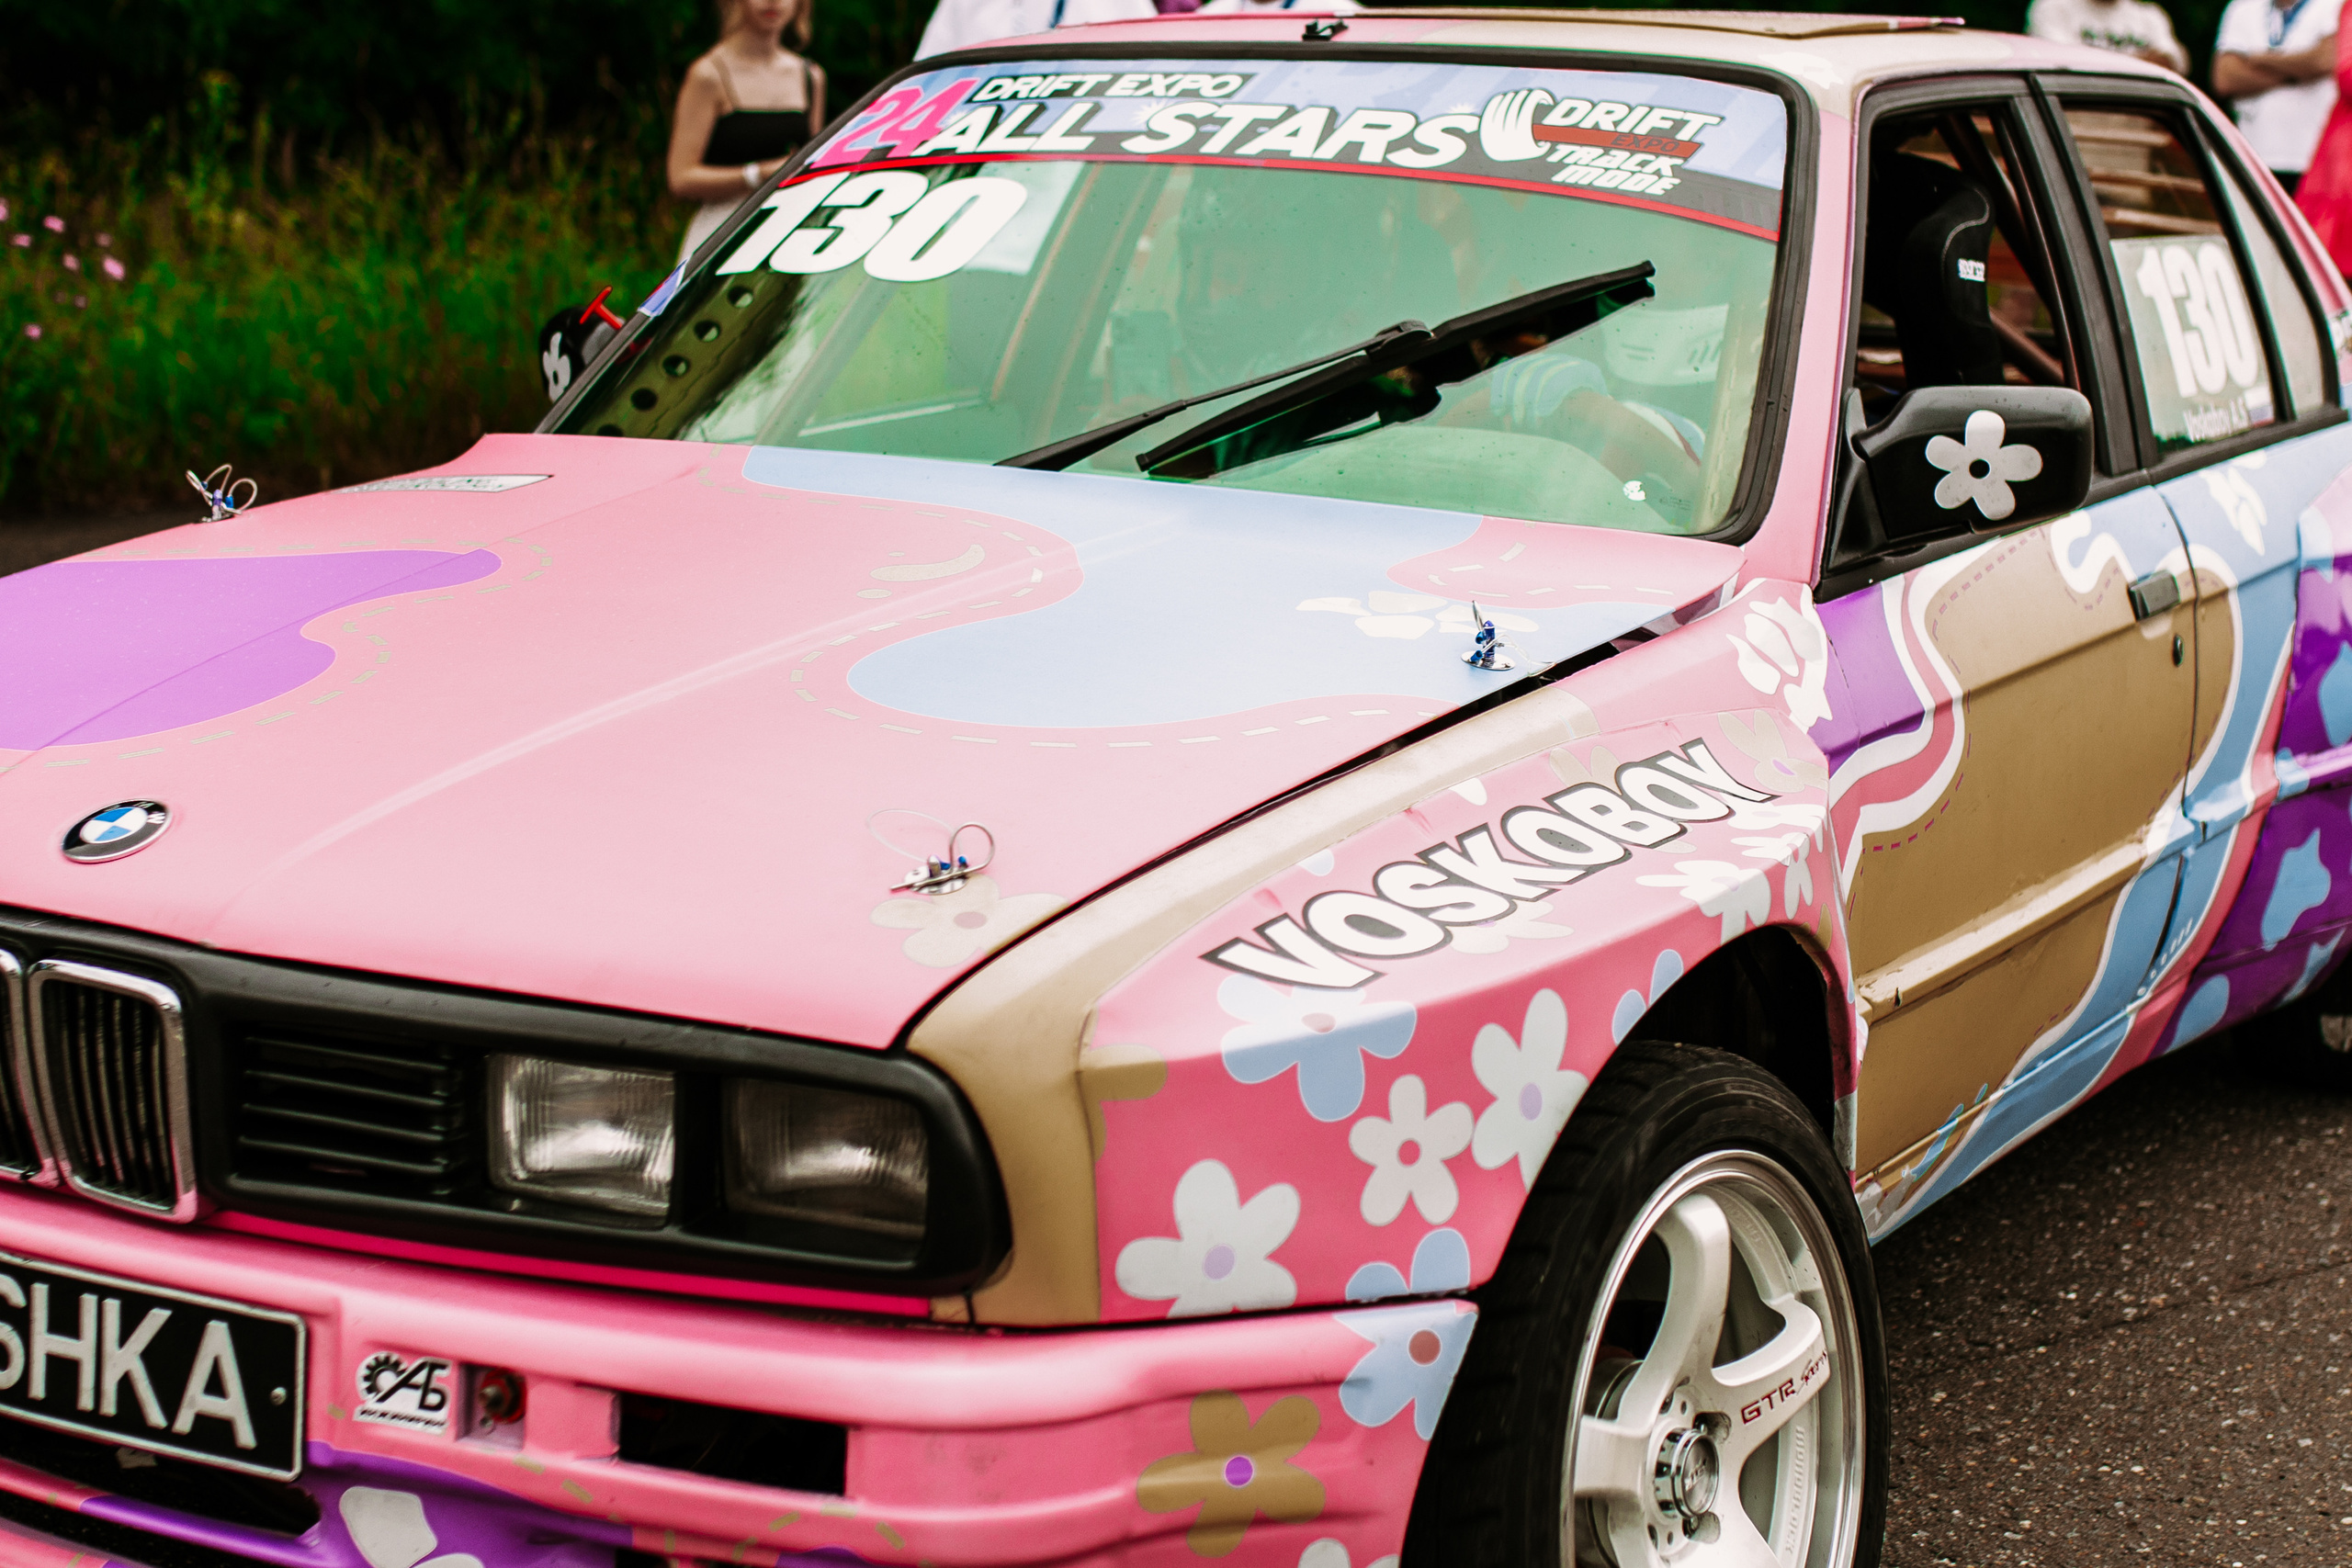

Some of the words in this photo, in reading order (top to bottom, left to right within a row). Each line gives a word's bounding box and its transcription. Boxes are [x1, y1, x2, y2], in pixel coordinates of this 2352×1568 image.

[972, 73, 1113, 102] DRIFT
[1104, 73, 1243, 98] EXPO
[1542, 98, 1724, 141] DRIFT
[820, 77, 980, 168] 24
[910, 102, 1097, 156] ALL
[1120, 101, 1480, 168] STARS
[1610, 133, 1679, 153] EXPO
[716, 170, 1027, 282] 130
[2136, 242, 2259, 399] 130
[1198, 739, 1781, 990] VOSKOBOY
[1741, 1378, 1796, 1425] GTR
